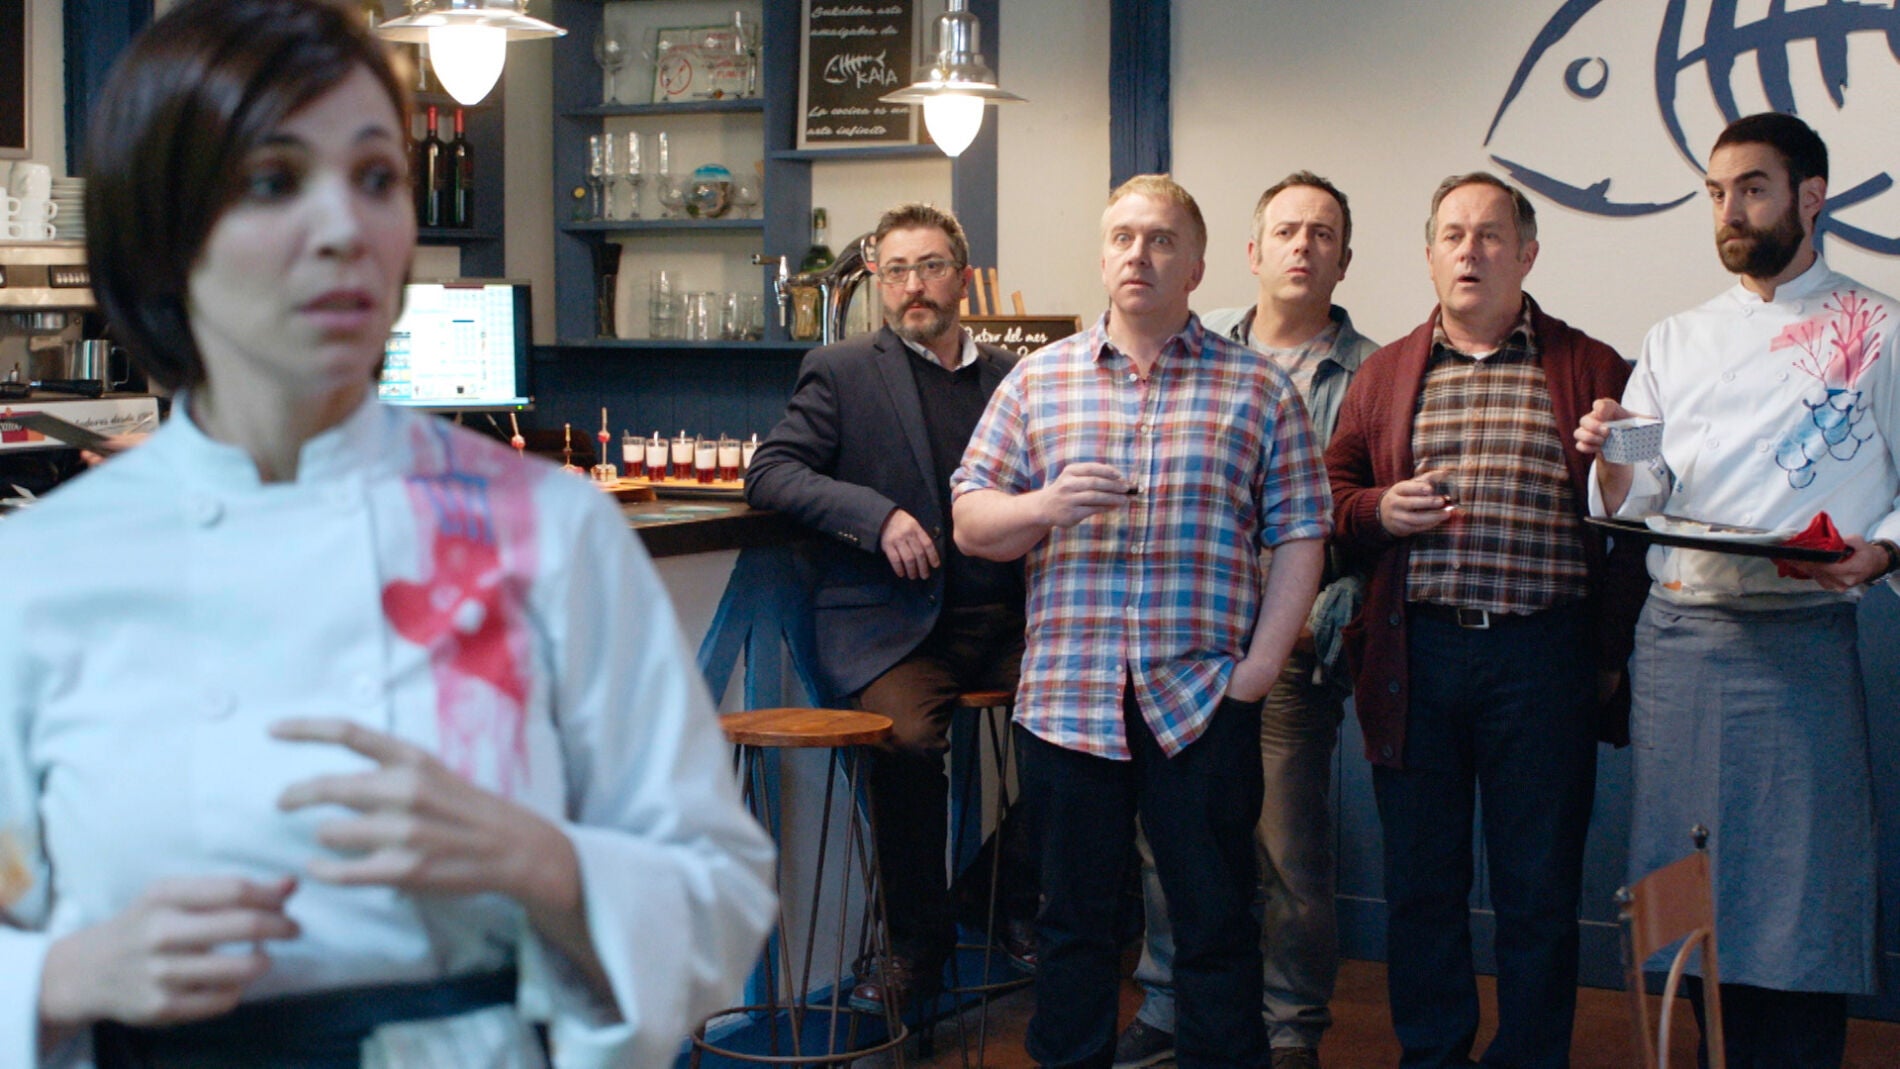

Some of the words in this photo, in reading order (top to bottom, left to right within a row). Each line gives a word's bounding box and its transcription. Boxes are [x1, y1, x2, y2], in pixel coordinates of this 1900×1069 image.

[836, 126, 887, 137] infinito
[1003, 326, 1024, 343] del
[1025, 333, 1049, 344] mes
